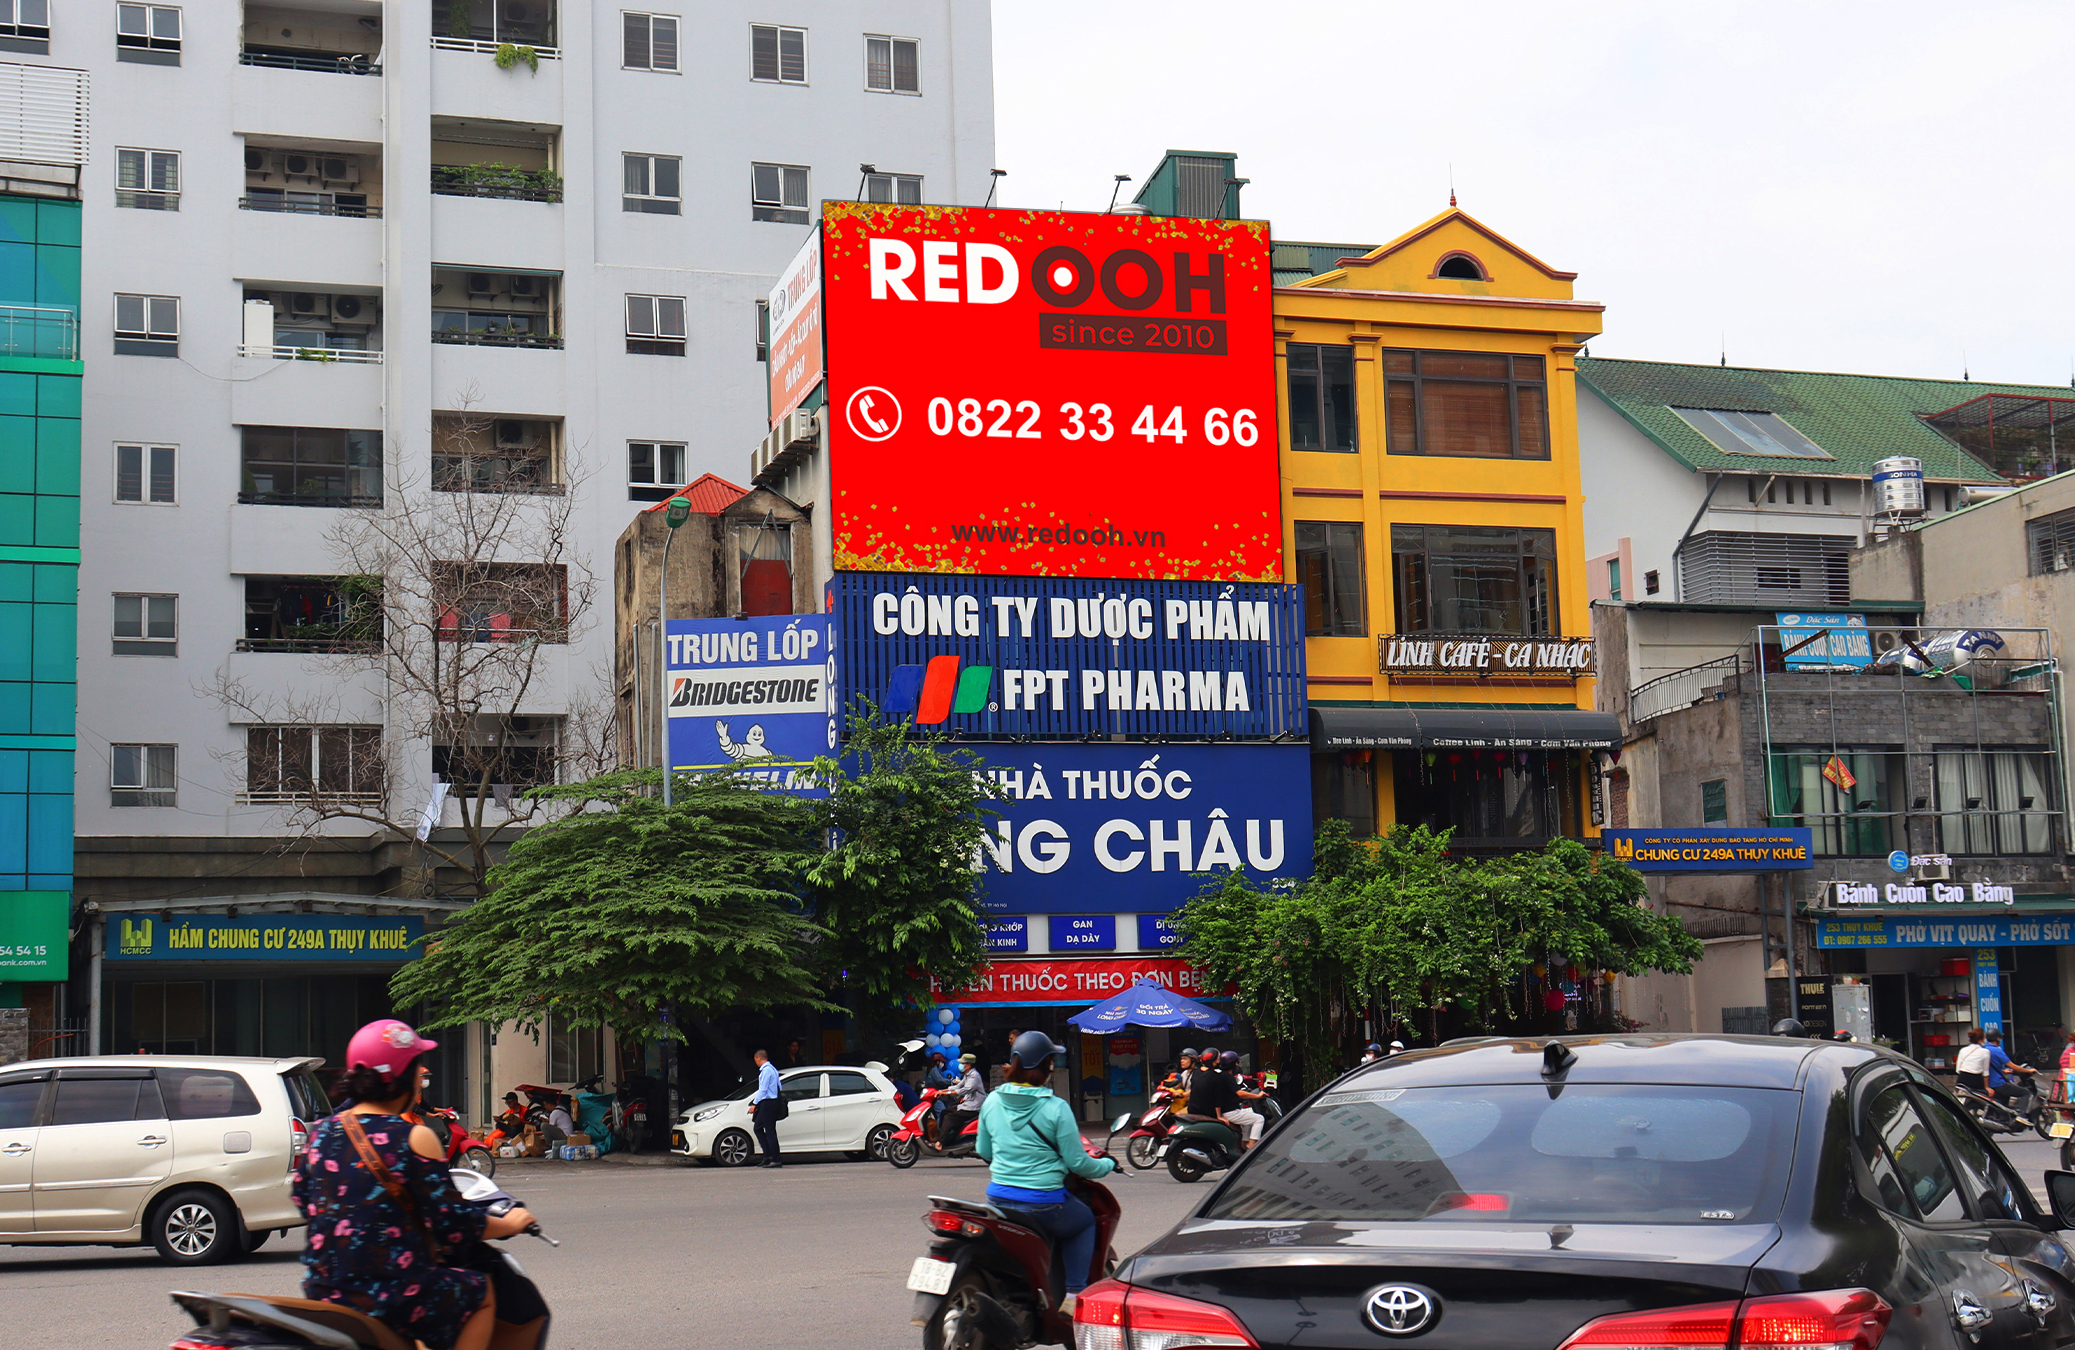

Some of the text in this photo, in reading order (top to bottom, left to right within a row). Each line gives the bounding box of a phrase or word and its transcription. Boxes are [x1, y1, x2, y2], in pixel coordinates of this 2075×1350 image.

[869, 237, 1227, 314] RED OOH
[1051, 321, 1216, 349] since 2010
[927, 396, 1260, 448] 0822 33 44 66
[950, 521, 1167, 549] www.redooh.vn
[872, 584, 1271, 646] CÔNG TY DƯỢC PHẨM
[667, 618, 819, 665] TRUNG LỐP
[1829, 634, 1847, 657] CAO
[1439, 637, 1490, 668] CAFÉ
[1504, 642, 1531, 668] CA
[1535, 642, 1591, 674] NHẠC
[669, 677, 819, 708] BRIDGESTONE
[826, 622, 837, 750] LONG
[1003, 668, 1250, 712] FPT PHARMA
[971, 753, 1193, 800] NHÀ THUỐC
[969, 807, 1286, 874] NG CHÂU
[1644, 836, 1661, 844] CÔNG
[1635, 845, 1807, 863] CHUNG CƯ 249A THỤY KHUÊ
[1836, 876, 2014, 906] Bánh Cuốn Cao Bằng
[168, 921, 408, 954] HẦM CHUNG CƯ 249A THỤY KHUÊ
[1072, 920, 1093, 929] GAN
[1826, 922, 1841, 932] 253
[1842, 922, 1861, 934] THỤY
[1895, 919, 1927, 943] PHỞ
[1930, 923, 1955, 945] VỊT
[1957, 923, 1997, 945] QUAY
[2010, 917, 2040, 941] PHỞ
[2043, 917, 2071, 941] SỐT
[0, 945, 47, 956] 54 54 15
[120, 947, 153, 955] HCMCC
[997, 938, 1017, 947] KINH
[1066, 933, 1100, 945] DẠ DÀY
[1837, 935, 1855, 945] 0907
[1857, 935, 1871, 945] 266
[1873, 934, 1888, 945] 555
[1977, 948, 1996, 961] 253
[1002, 967, 1068, 992] THUỐC
[1074, 971, 1125, 990] THEO
[1799, 983, 1825, 995] THULE
[1978, 970, 1998, 988] BÁNH
[1980, 992, 2000, 1012] CUỐN
